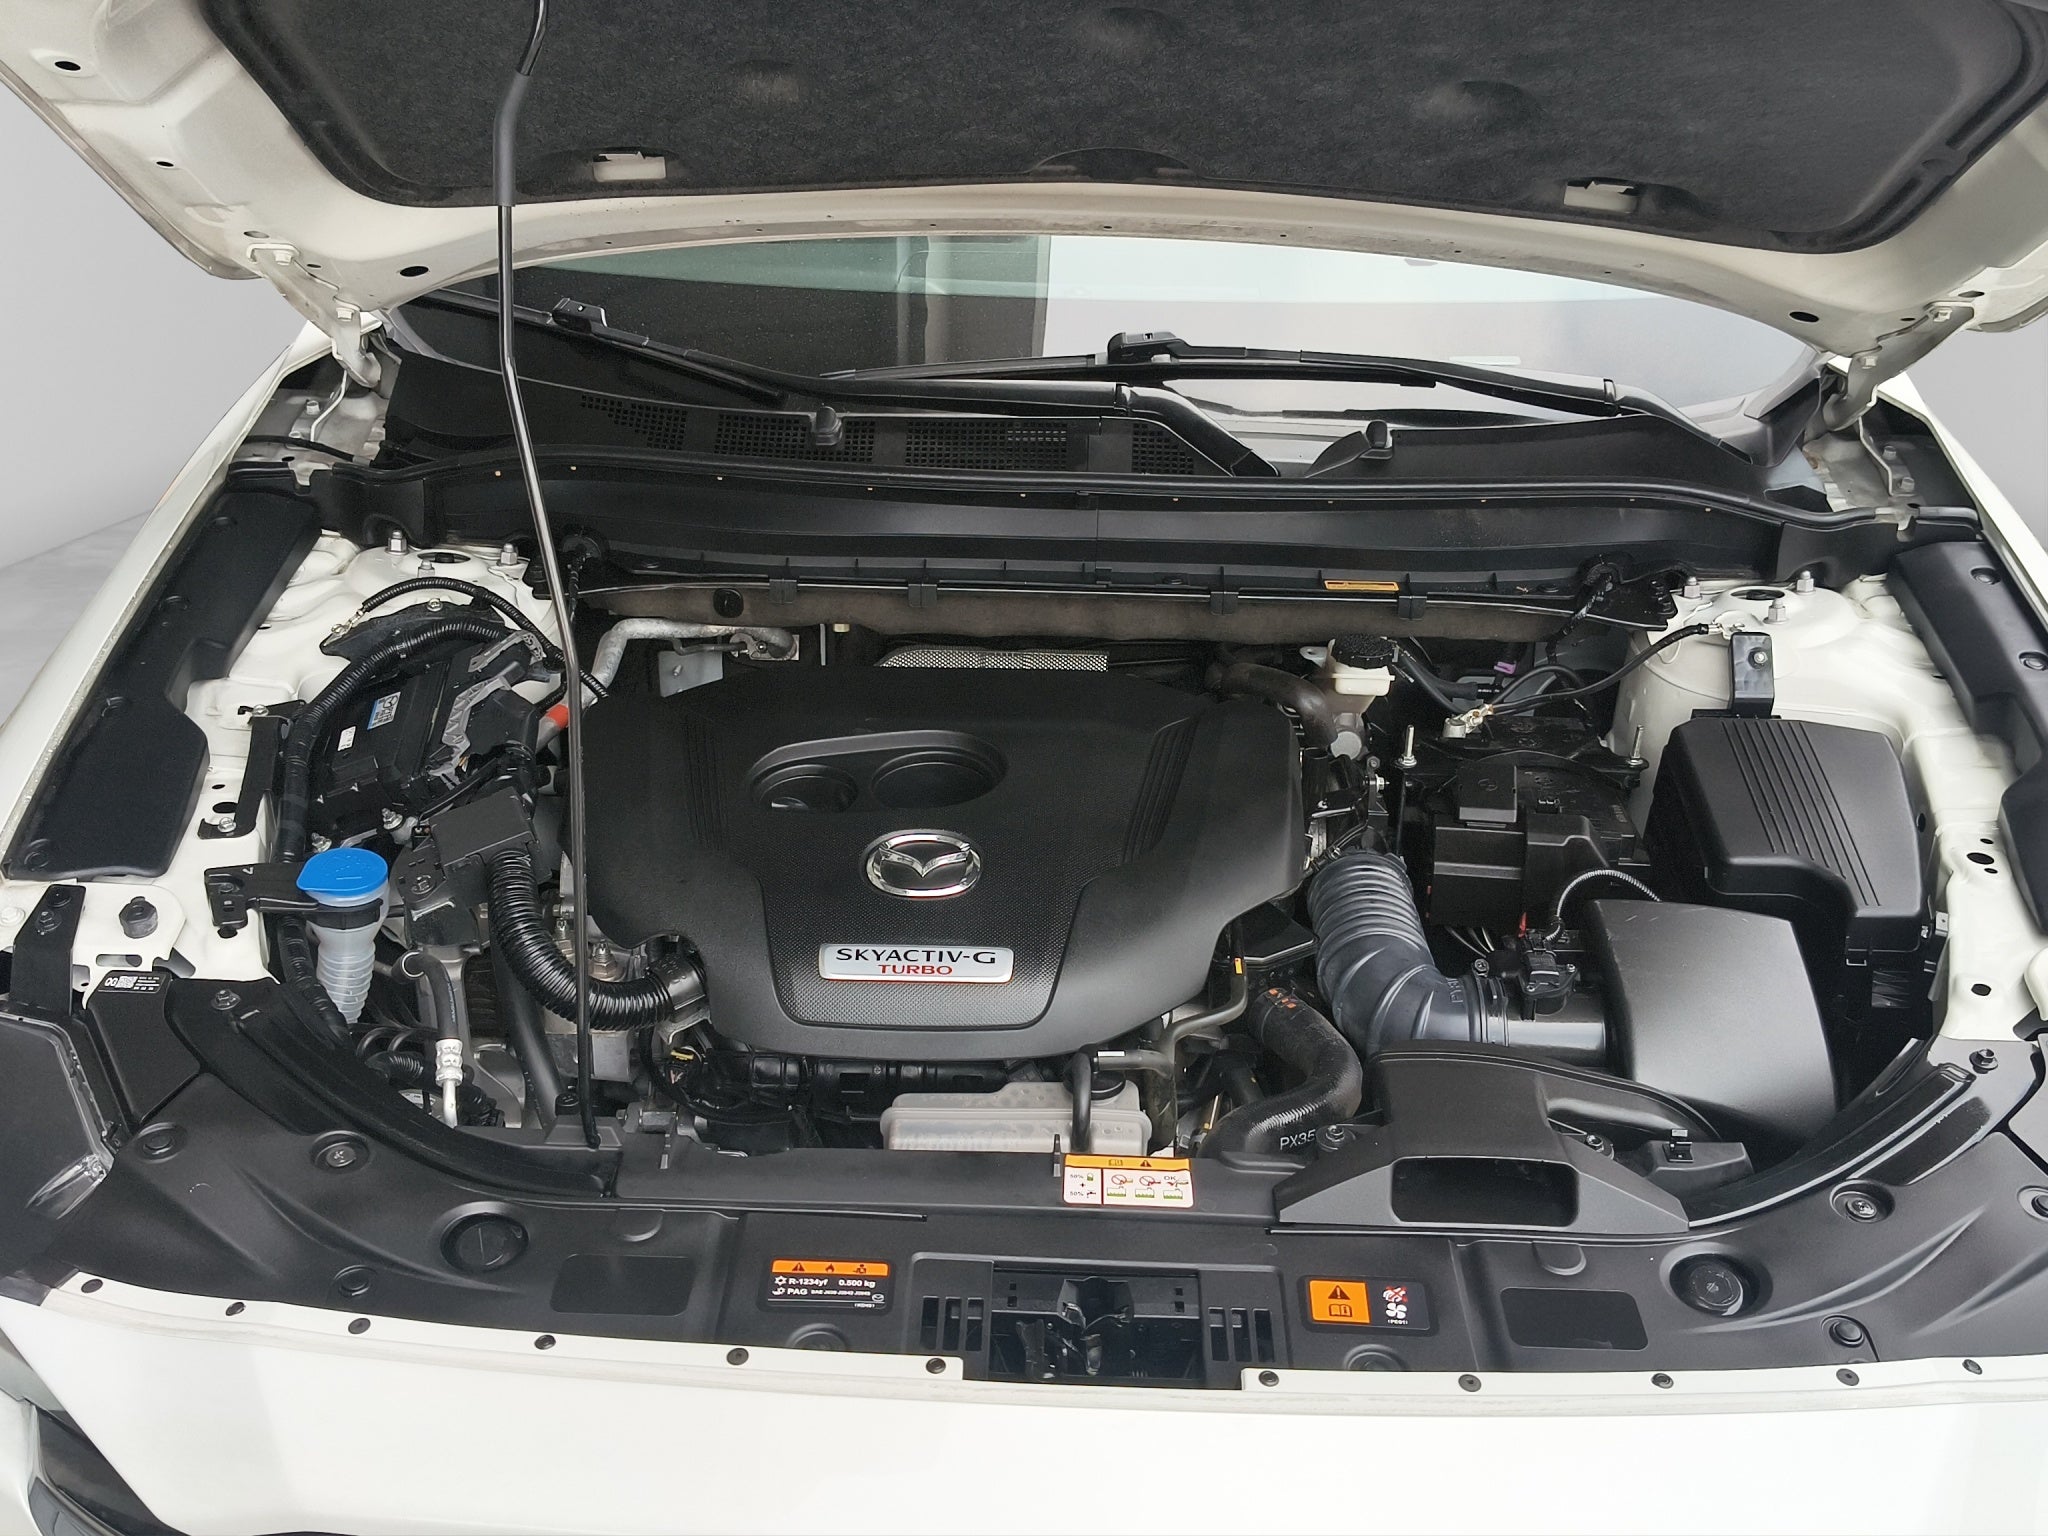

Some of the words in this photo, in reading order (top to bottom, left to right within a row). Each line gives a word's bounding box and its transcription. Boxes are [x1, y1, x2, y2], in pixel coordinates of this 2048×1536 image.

[835, 948, 996, 964] SKYACTIV-G
[878, 964, 953, 975] TURBO
[788, 1278, 828, 1286] R-1234yf
[864, 1280, 876, 1288] kg
